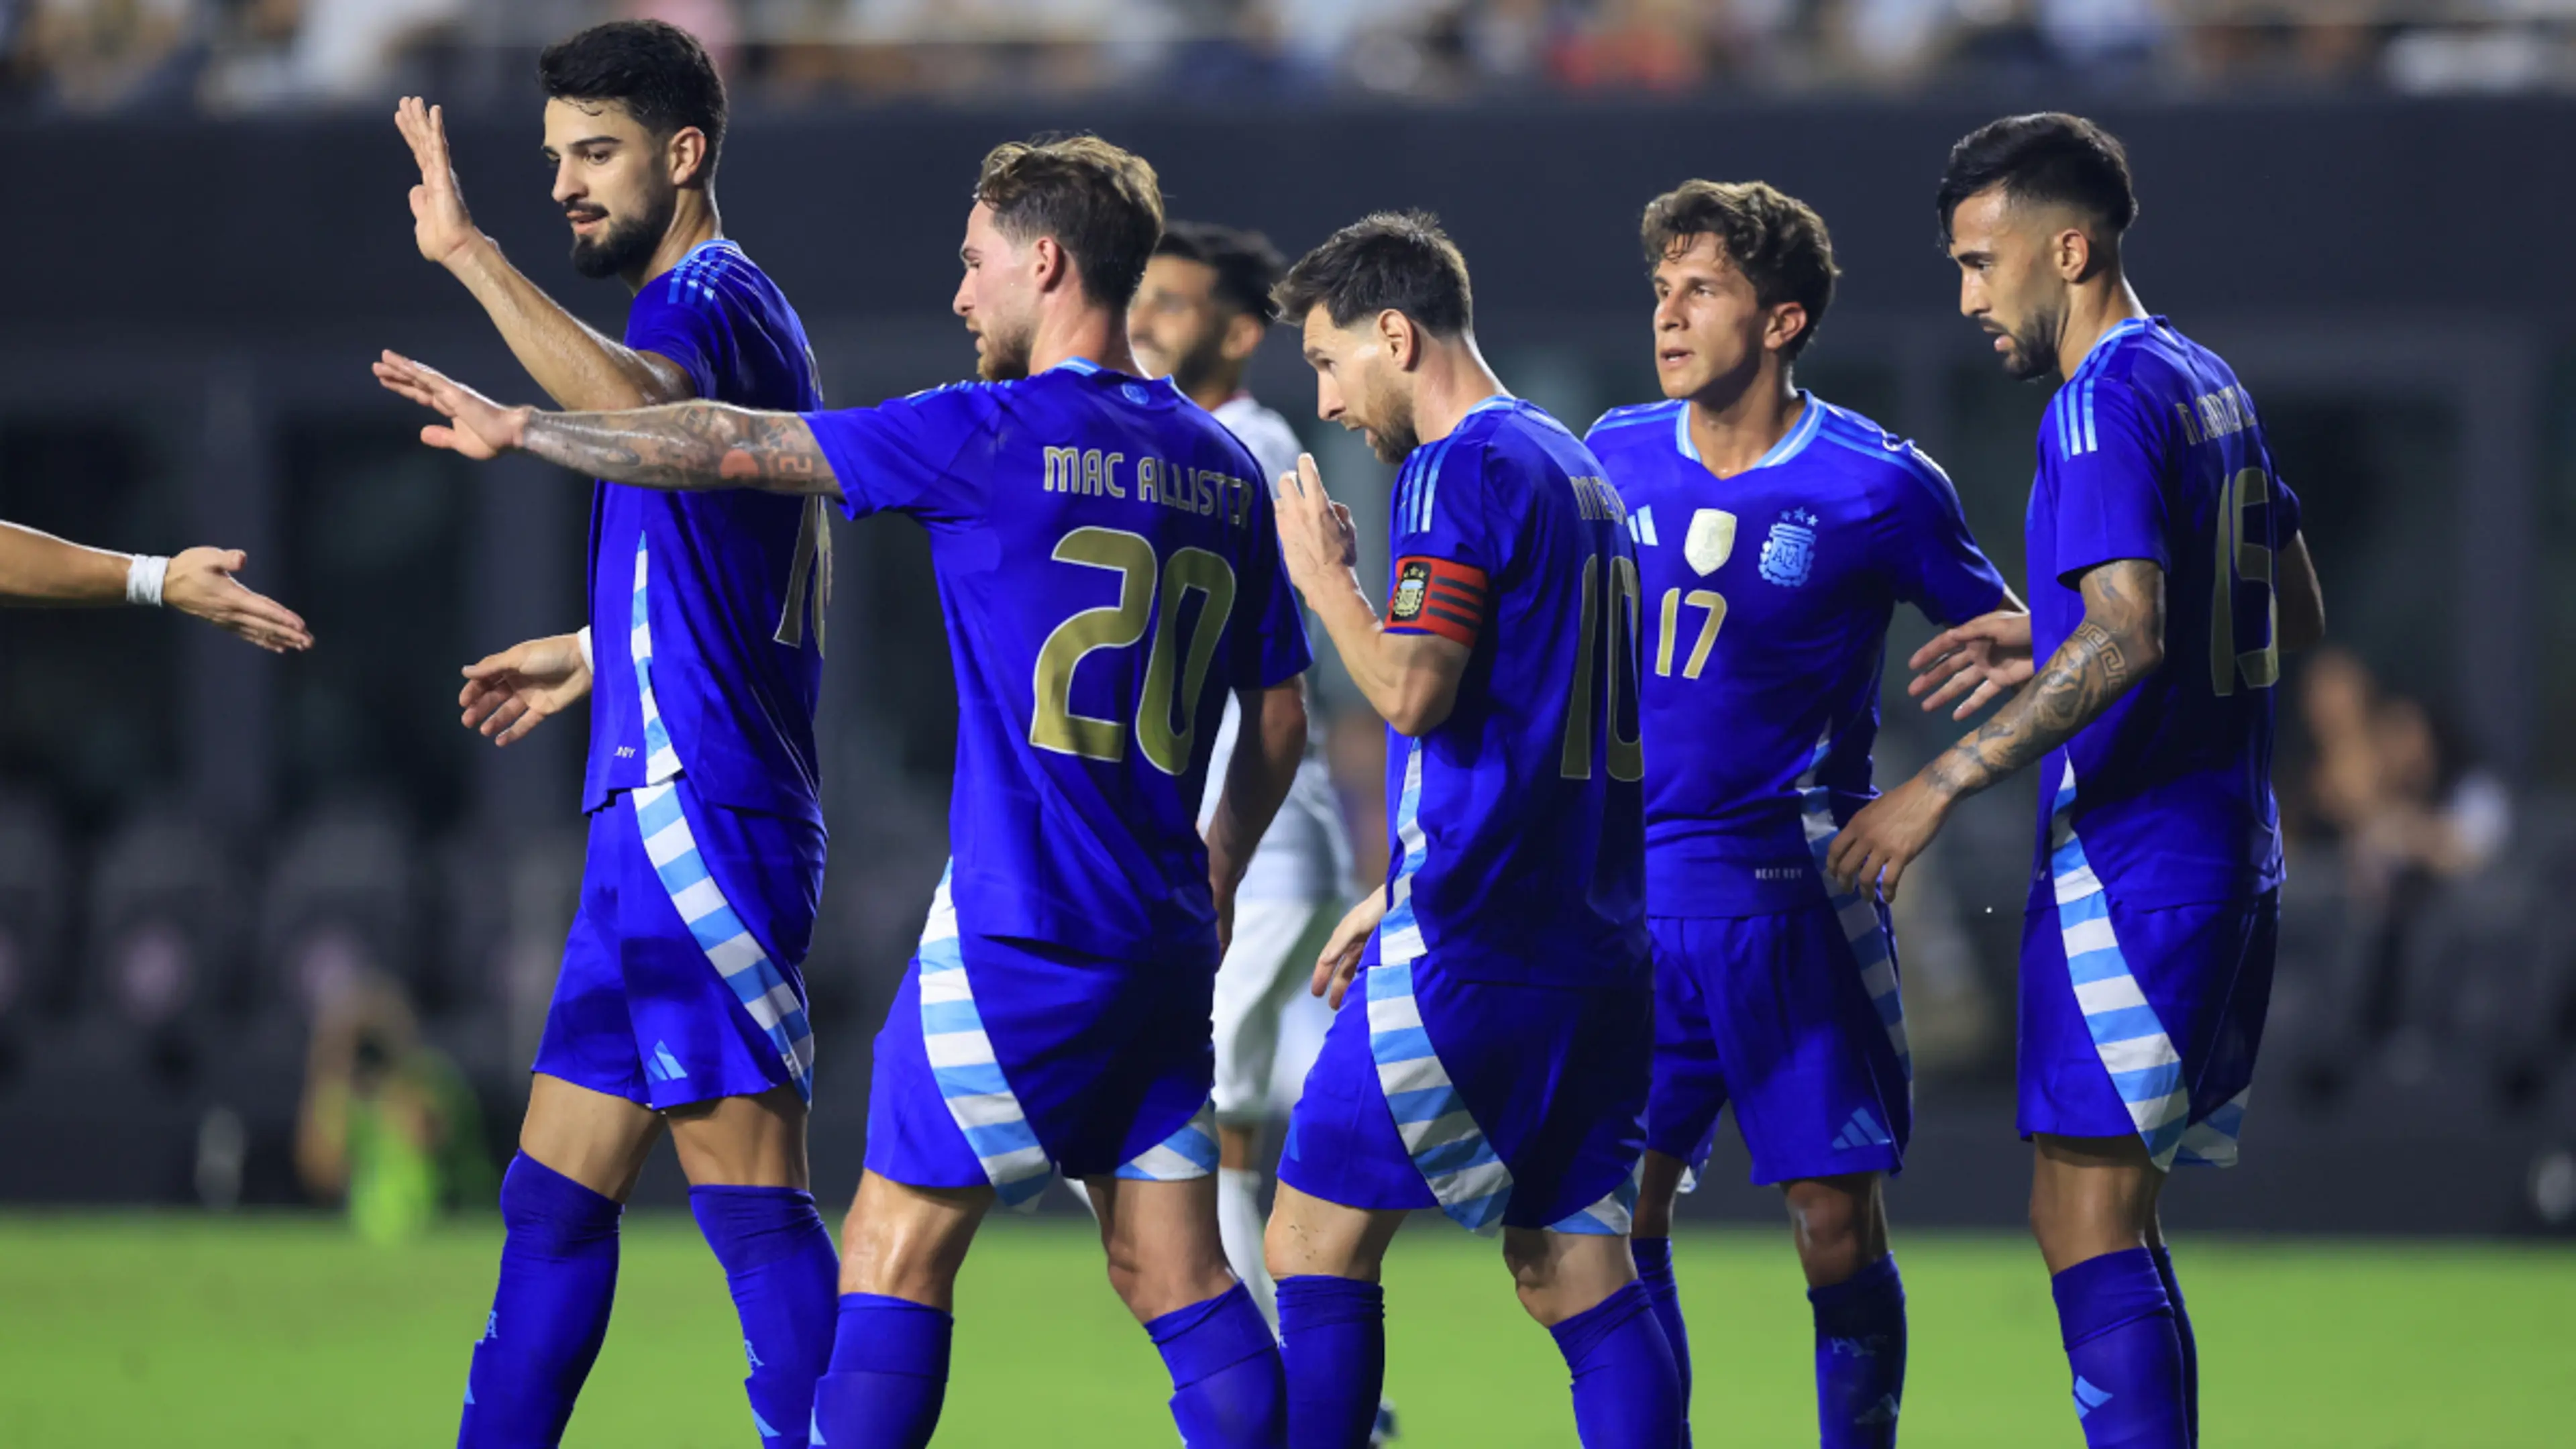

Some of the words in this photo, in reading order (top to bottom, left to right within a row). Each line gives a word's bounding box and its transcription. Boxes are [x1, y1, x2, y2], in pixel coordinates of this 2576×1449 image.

[1043, 446, 1126, 498] MAC
[1137, 456, 1253, 529] ALLISTER
[2210, 467, 2279, 696] 15
[1029, 525, 1236, 776] 20
[1560, 553, 1645, 782] 10
[1655, 587, 1728, 679] 17
